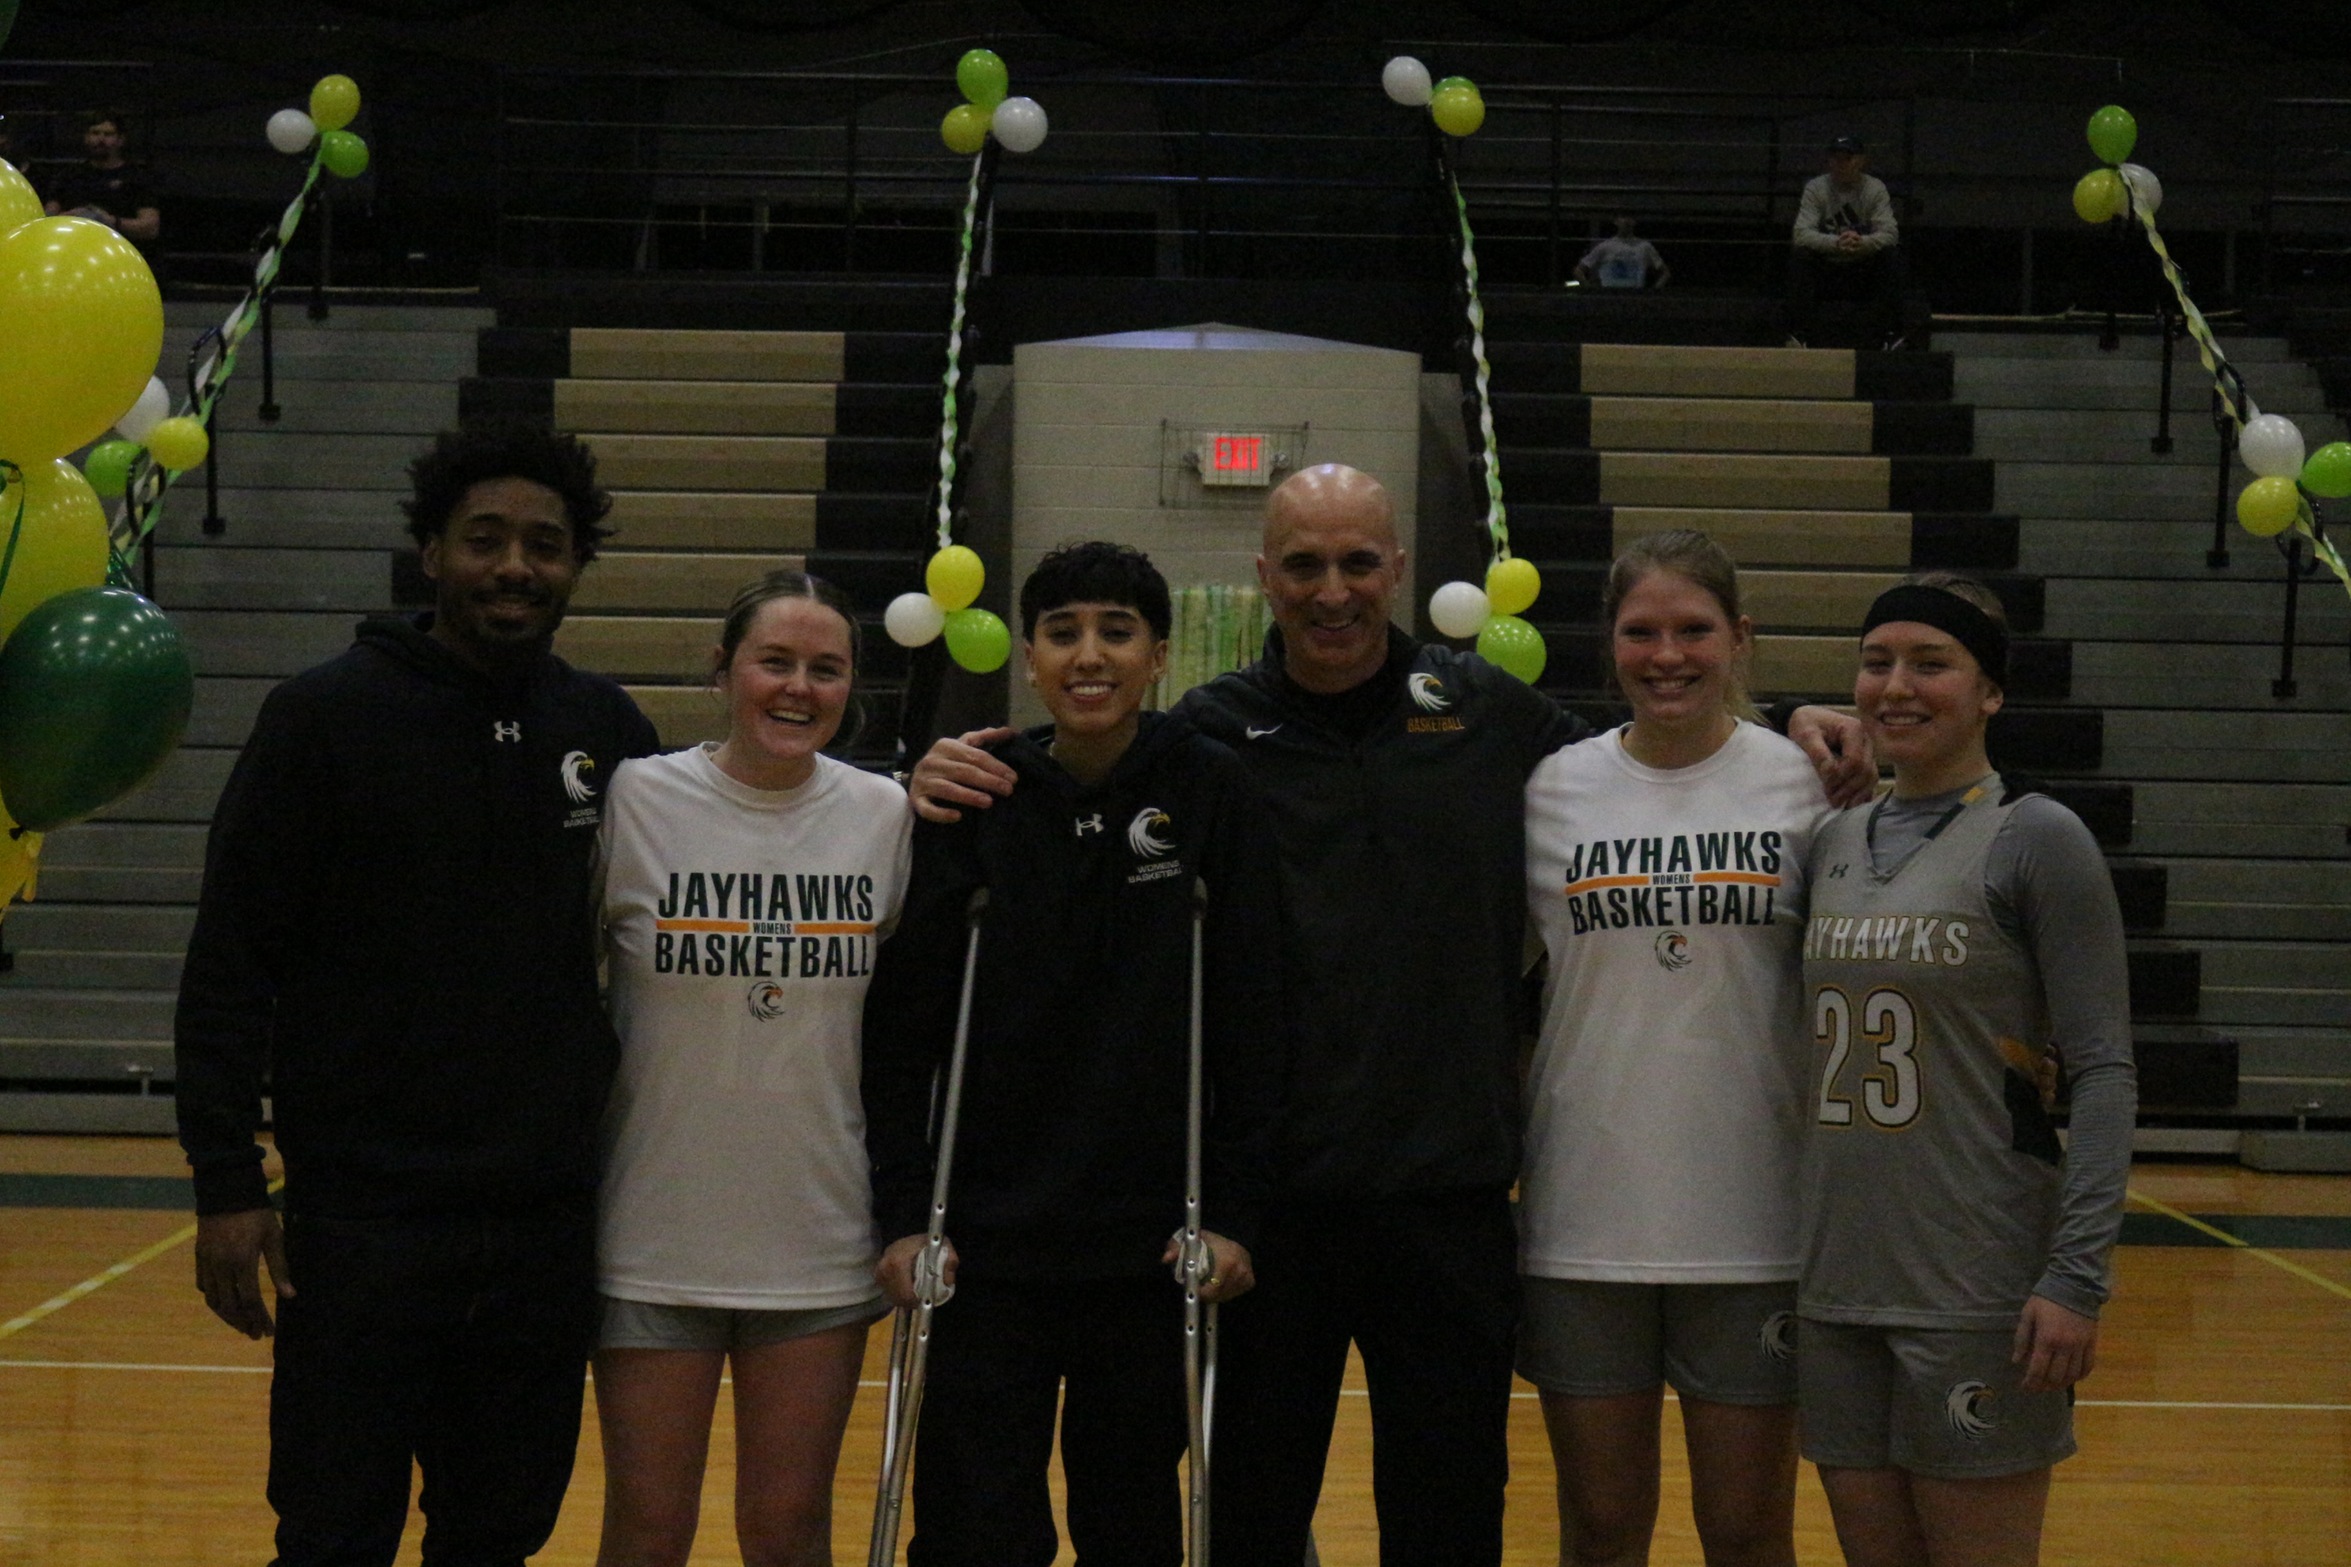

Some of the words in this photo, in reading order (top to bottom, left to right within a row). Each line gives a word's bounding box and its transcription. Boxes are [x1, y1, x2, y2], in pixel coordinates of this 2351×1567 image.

[1214, 436, 1262, 471] EXIT
[1407, 714, 1466, 734] BASKETBALL
[1137, 859, 1181, 874] WOMENS
[1566, 831, 1781, 883] JAYHAWKS
[1652, 873, 1691, 885] WOMENS
[658, 872, 873, 922] JAYHAWKS
[1569, 884, 1776, 935] BASKETBALL
[753, 921, 792, 935] WOMENS
[1803, 916, 1970, 967] AYHAWKS
[655, 933, 870, 979] BASKETBALL
[1815, 985, 1923, 1129] 23
